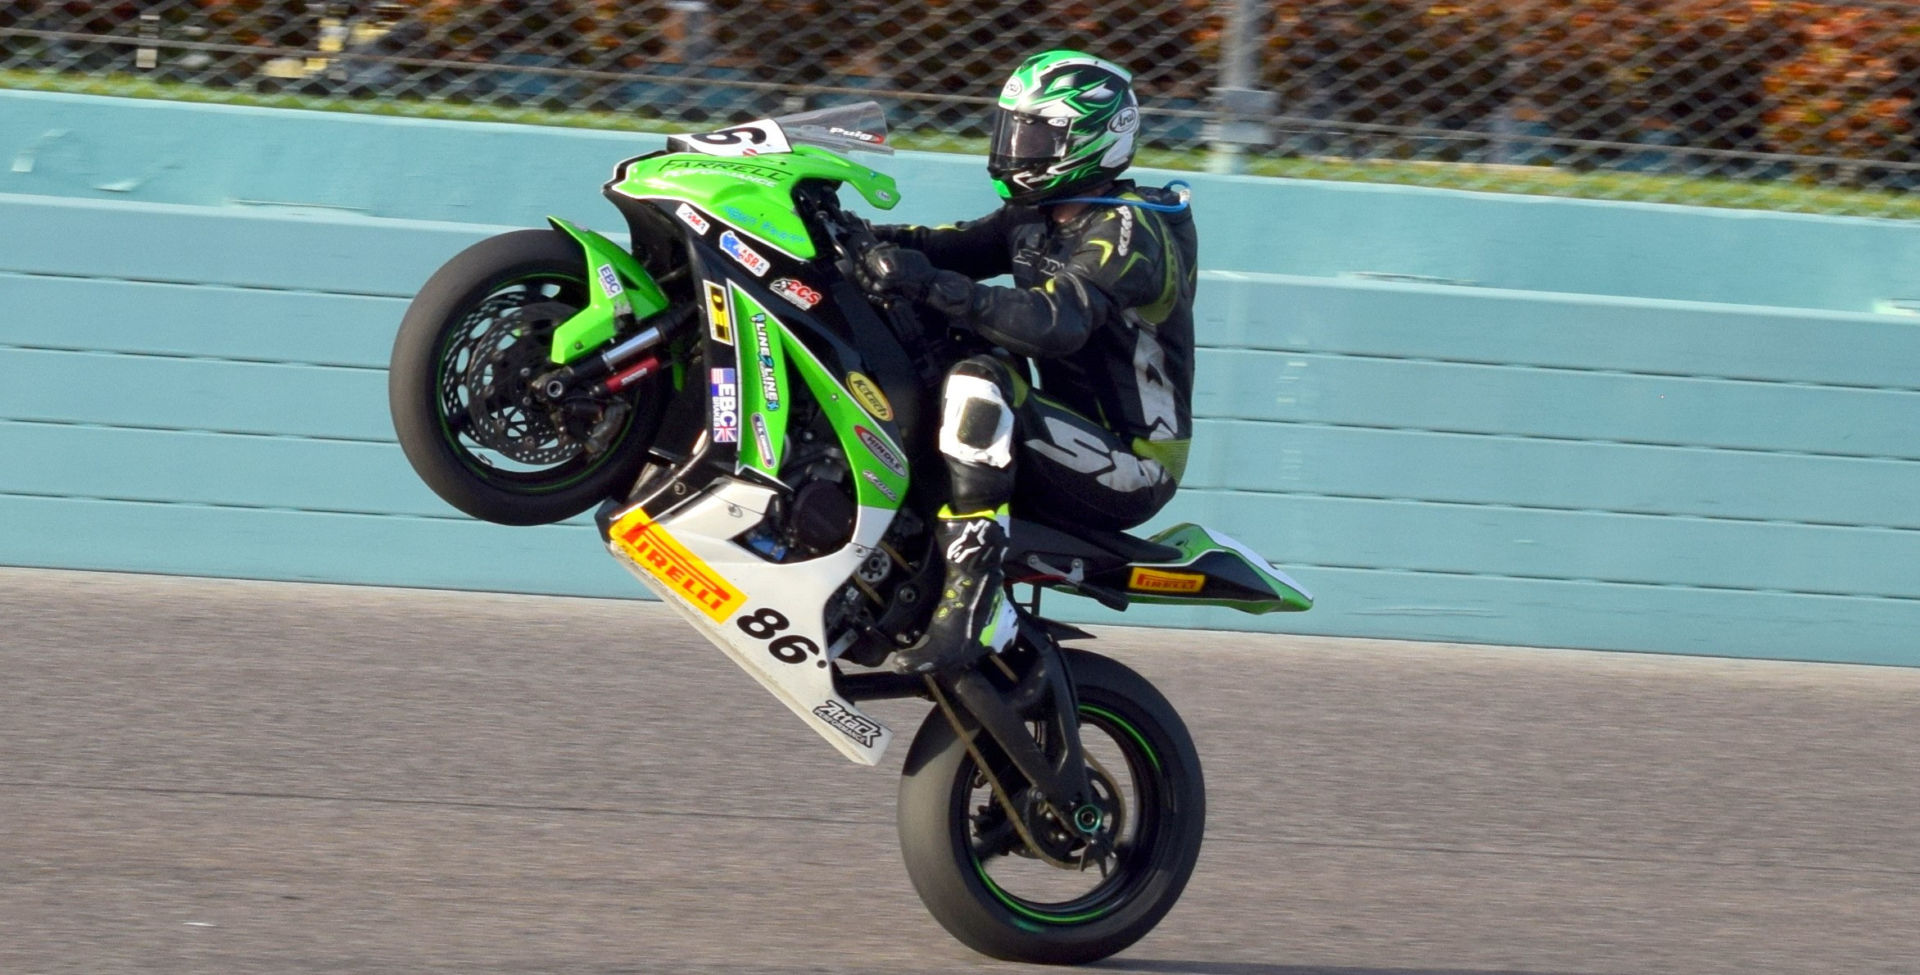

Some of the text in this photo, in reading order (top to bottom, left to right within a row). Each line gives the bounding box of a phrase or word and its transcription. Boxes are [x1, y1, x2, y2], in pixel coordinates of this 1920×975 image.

[829, 126, 874, 141] Puig
[658, 159, 794, 183] FARRELL
[600, 266, 621, 294] EBC
[788, 279, 822, 305] CCS
[718, 382, 738, 429] EBC
[621, 522, 731, 611] PIRELLI
[1136, 573, 1197, 592] PIRELLI
[736, 607, 820, 664] 86
[815, 699, 882, 748] Attack
